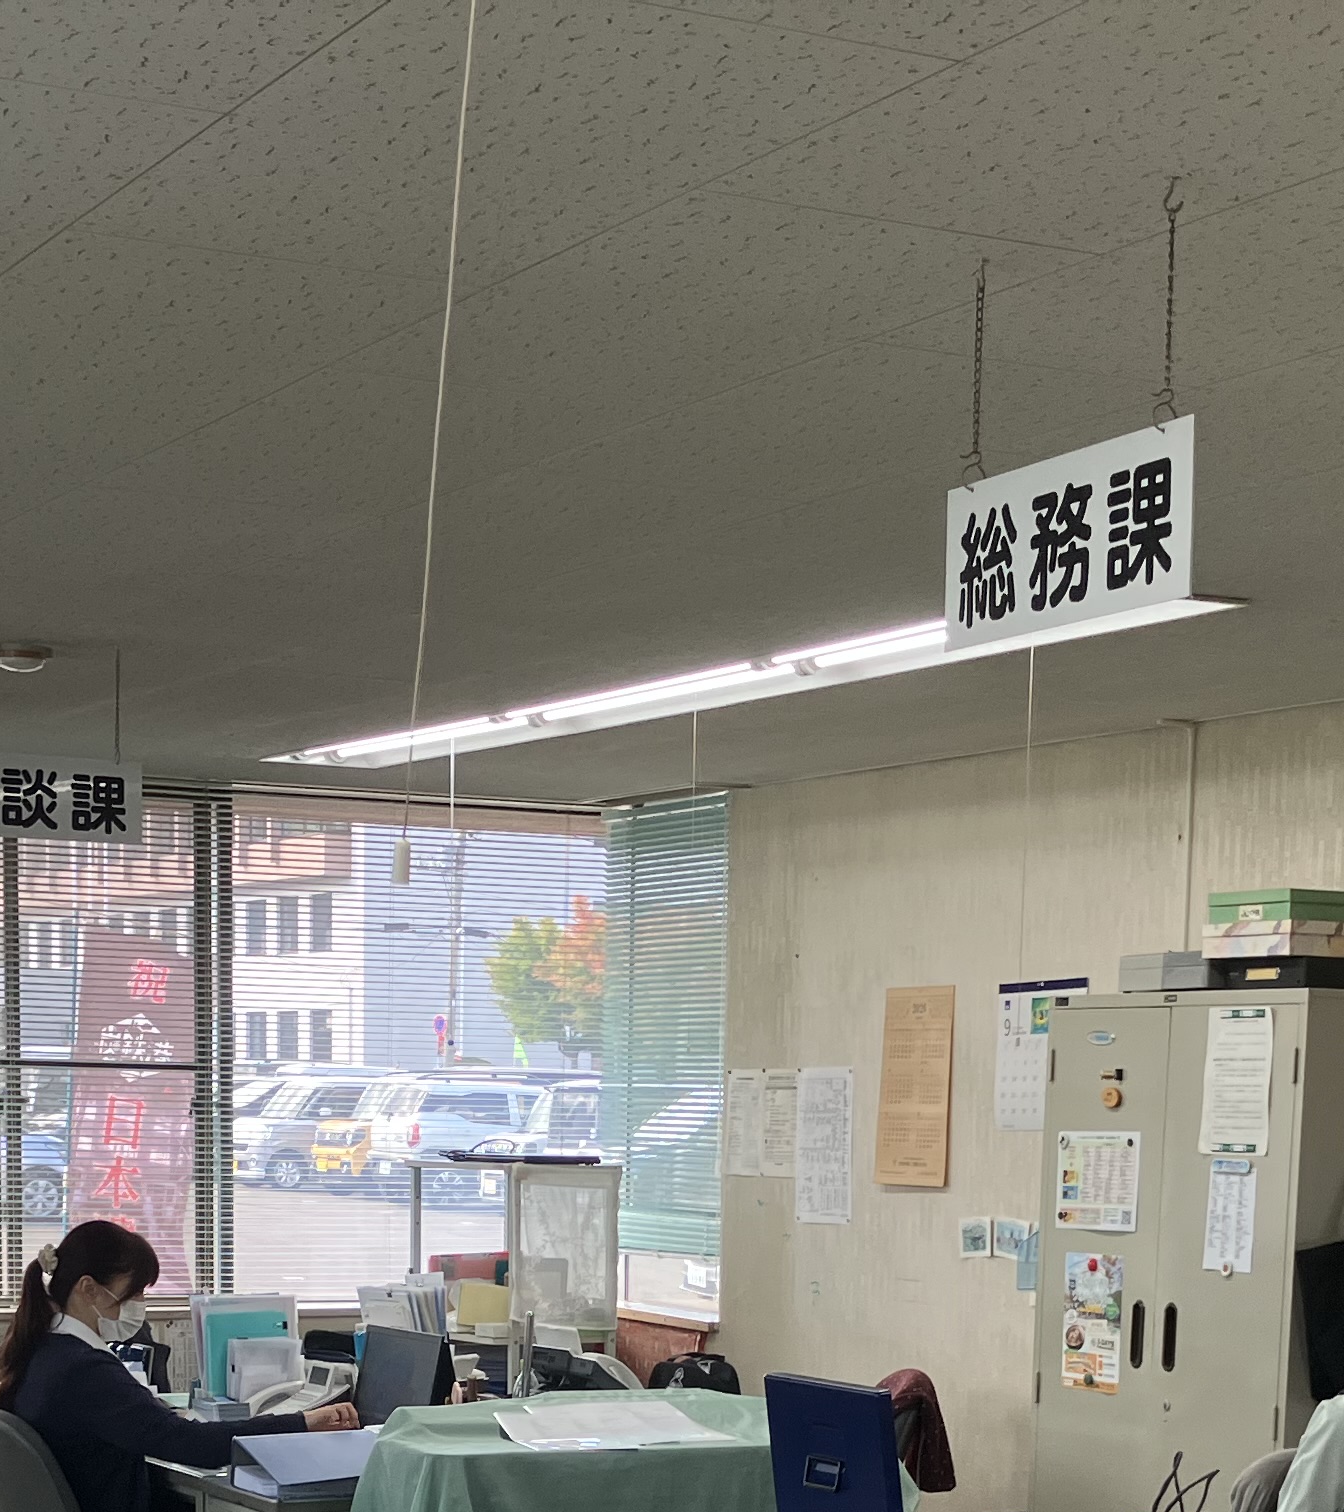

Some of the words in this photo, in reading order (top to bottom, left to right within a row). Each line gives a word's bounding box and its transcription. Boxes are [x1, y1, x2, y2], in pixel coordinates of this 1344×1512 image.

[959, 457, 1173, 629] 総務課
[127, 958, 170, 1004] 祝
[1003, 1018, 1012, 1037] 9
